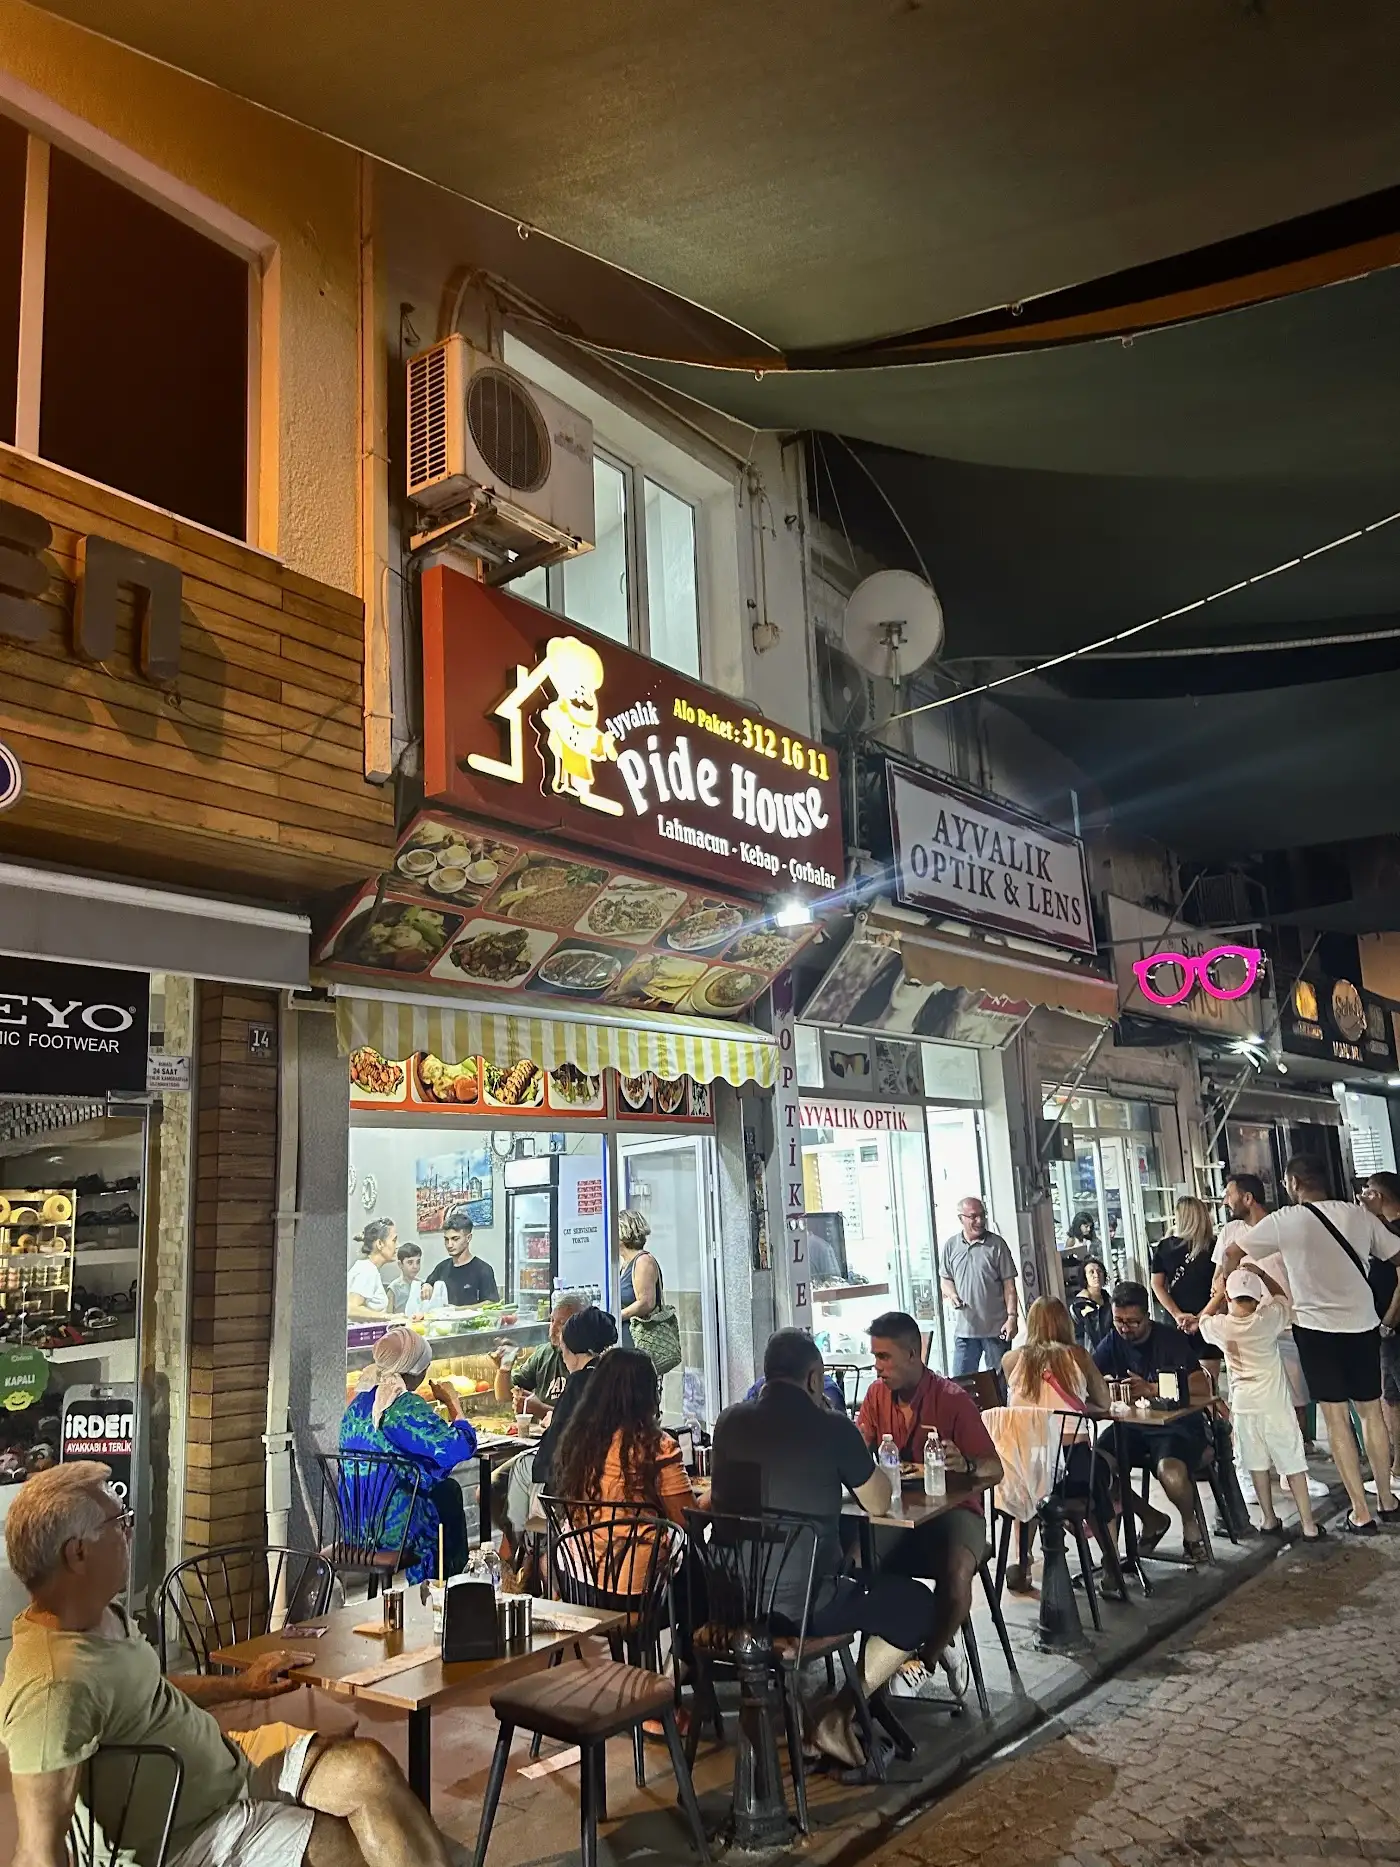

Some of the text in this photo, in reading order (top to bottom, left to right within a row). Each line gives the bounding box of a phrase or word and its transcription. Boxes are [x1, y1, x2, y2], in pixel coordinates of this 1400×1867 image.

[605, 700, 660, 741] Ayvalık
[673, 697, 696, 724] Alo
[741, 717, 778, 759] 312
[781, 736, 805, 770] 16
[807, 748, 830, 781] 11
[616, 734, 830, 839] Pide House
[657, 814, 730, 857] Lahmacun
[739, 841, 780, 877] Kebap
[788, 857, 837, 890] Çorbalar
[931, 809, 1053, 883] AYVALIK
[910, 843, 1082, 926] OPTİK & LENS
[0, 1030, 120, 1054] IC FOOTWEAR
[252, 1029, 269, 1048] 14
[863, 1105, 908, 1131] OPTİK
[66, 1442, 101, 1453] AYAKKABI
[102, 1443, 108, 1453] &
